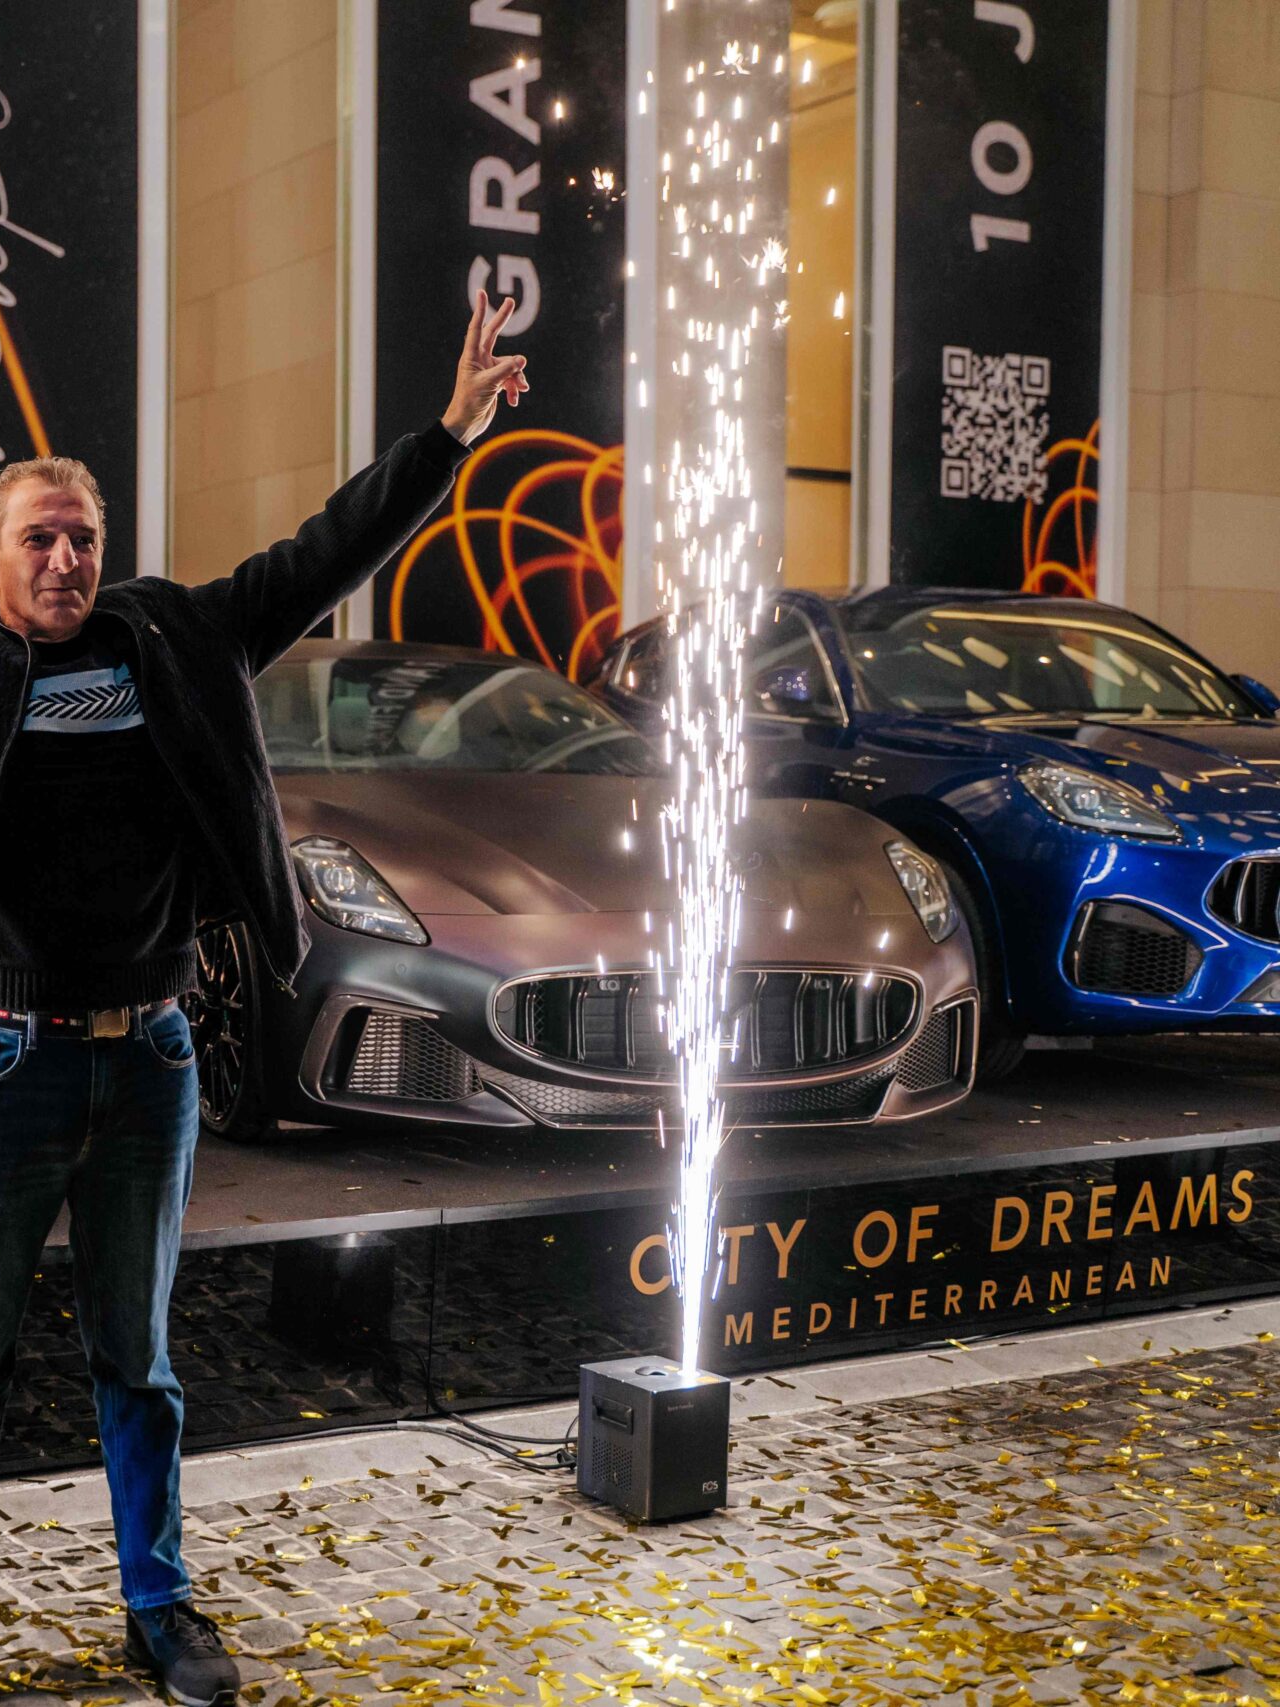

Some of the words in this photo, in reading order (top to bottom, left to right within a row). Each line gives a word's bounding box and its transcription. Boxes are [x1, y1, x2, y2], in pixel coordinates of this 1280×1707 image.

[970, 119, 1033, 252] 10
[629, 1219, 806, 1295] CTY
[852, 1204, 939, 1269] OF
[990, 1169, 1253, 1253] DREAMS
[725, 1255, 1171, 1347] MEDITERRANEAN
